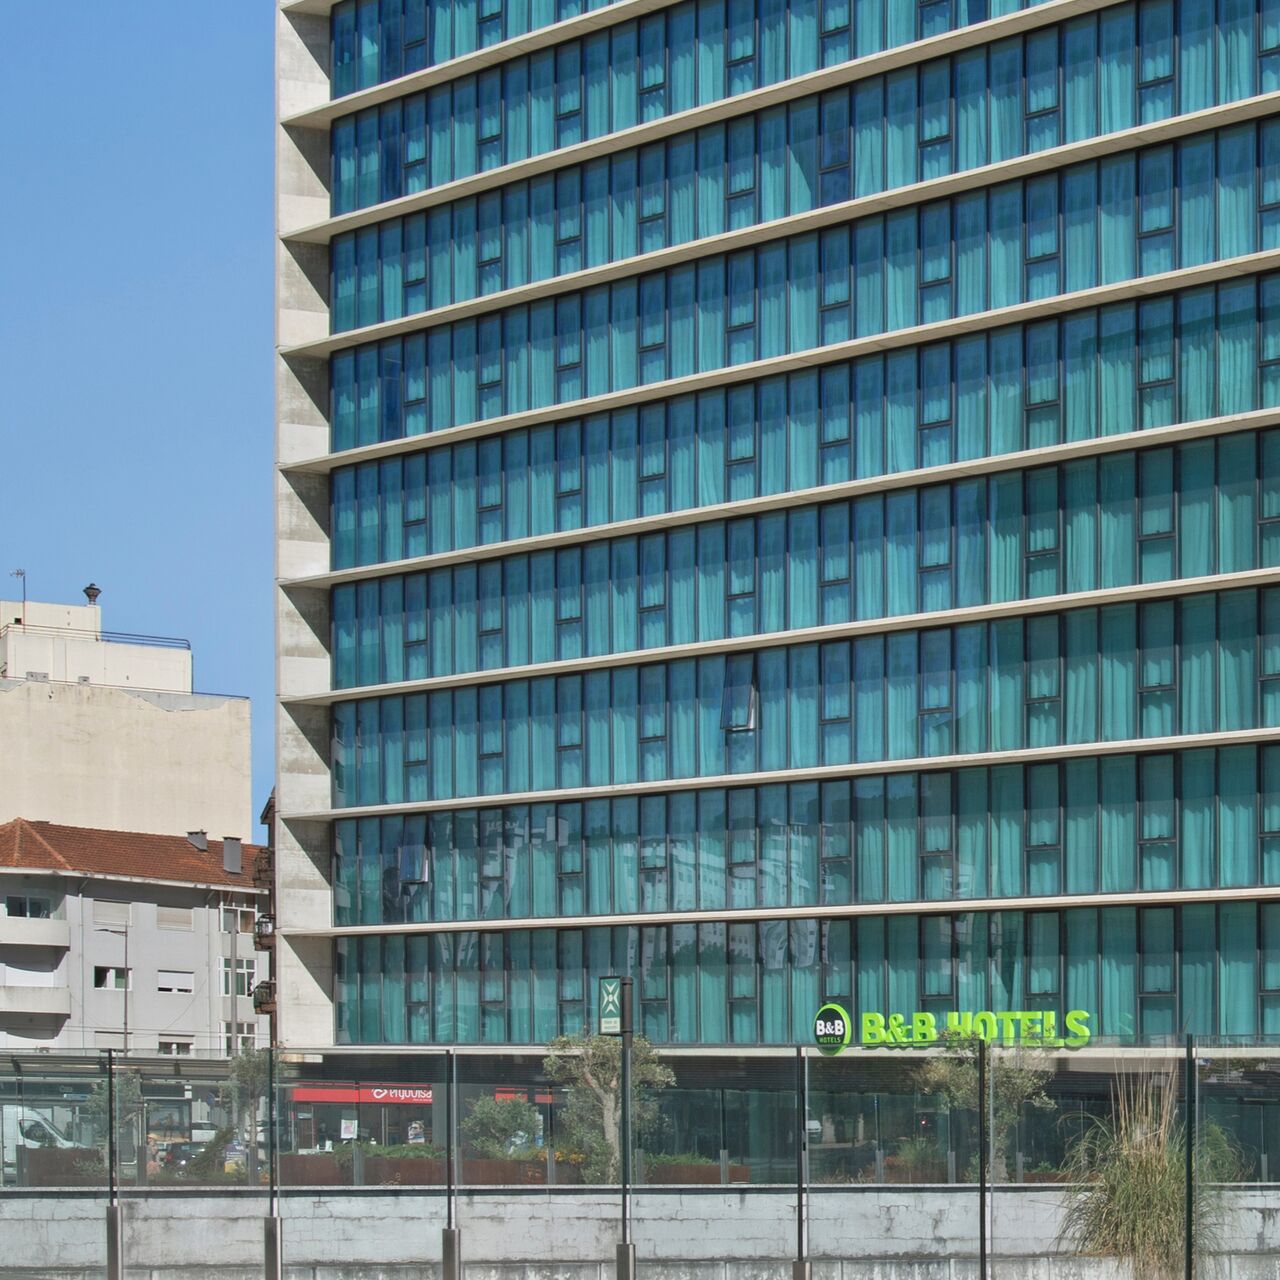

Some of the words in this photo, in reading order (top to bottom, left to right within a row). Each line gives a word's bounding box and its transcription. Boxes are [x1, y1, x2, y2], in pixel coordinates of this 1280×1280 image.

[815, 1019, 844, 1036] B&B
[861, 1011, 937, 1048] B&B
[946, 1009, 1091, 1048] HOTELS
[819, 1036, 842, 1044] HOTELS
